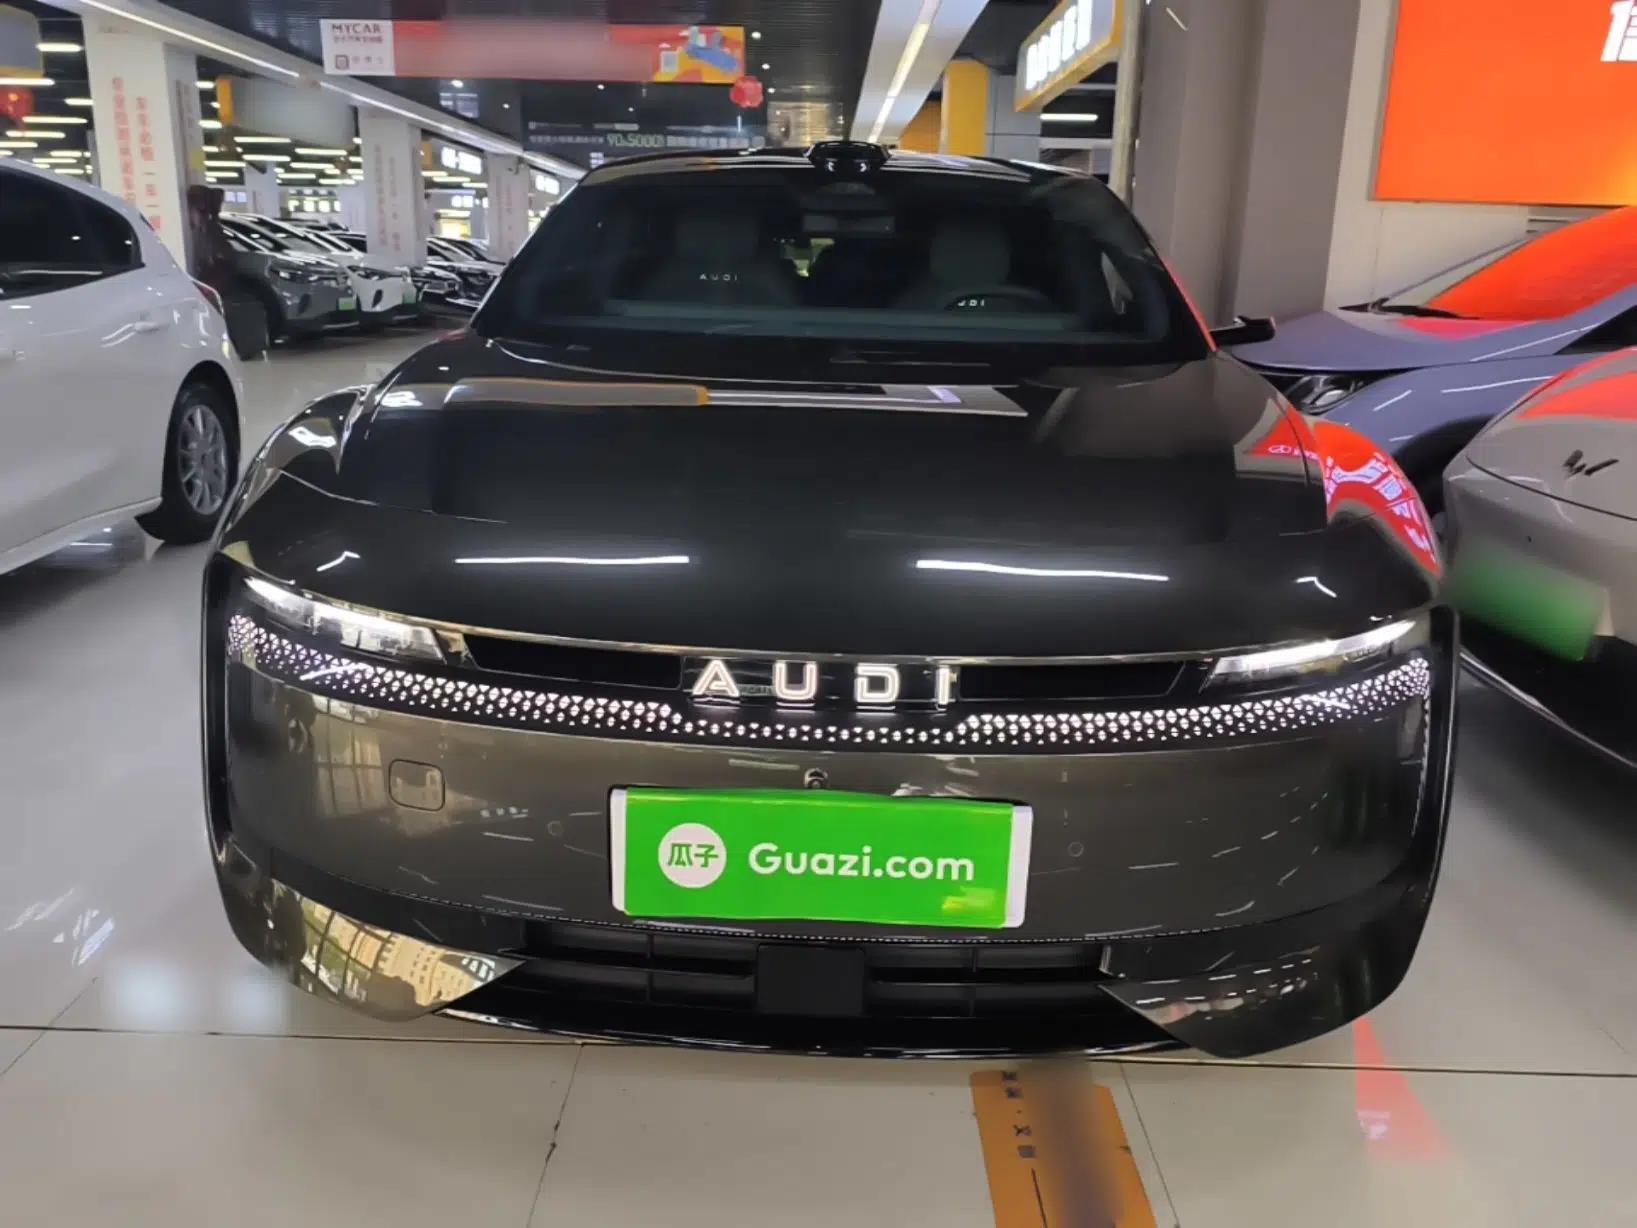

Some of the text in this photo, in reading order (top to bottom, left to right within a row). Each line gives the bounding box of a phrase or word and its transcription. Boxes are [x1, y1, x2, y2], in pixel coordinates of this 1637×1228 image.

[332, 23, 381, 34] MYCAR
[699, 273, 738, 281] AUDI
[692, 659, 951, 706] AUDI
[668, 843, 719, 868] 瓜子
[748, 842, 975, 881] Guazi.com
